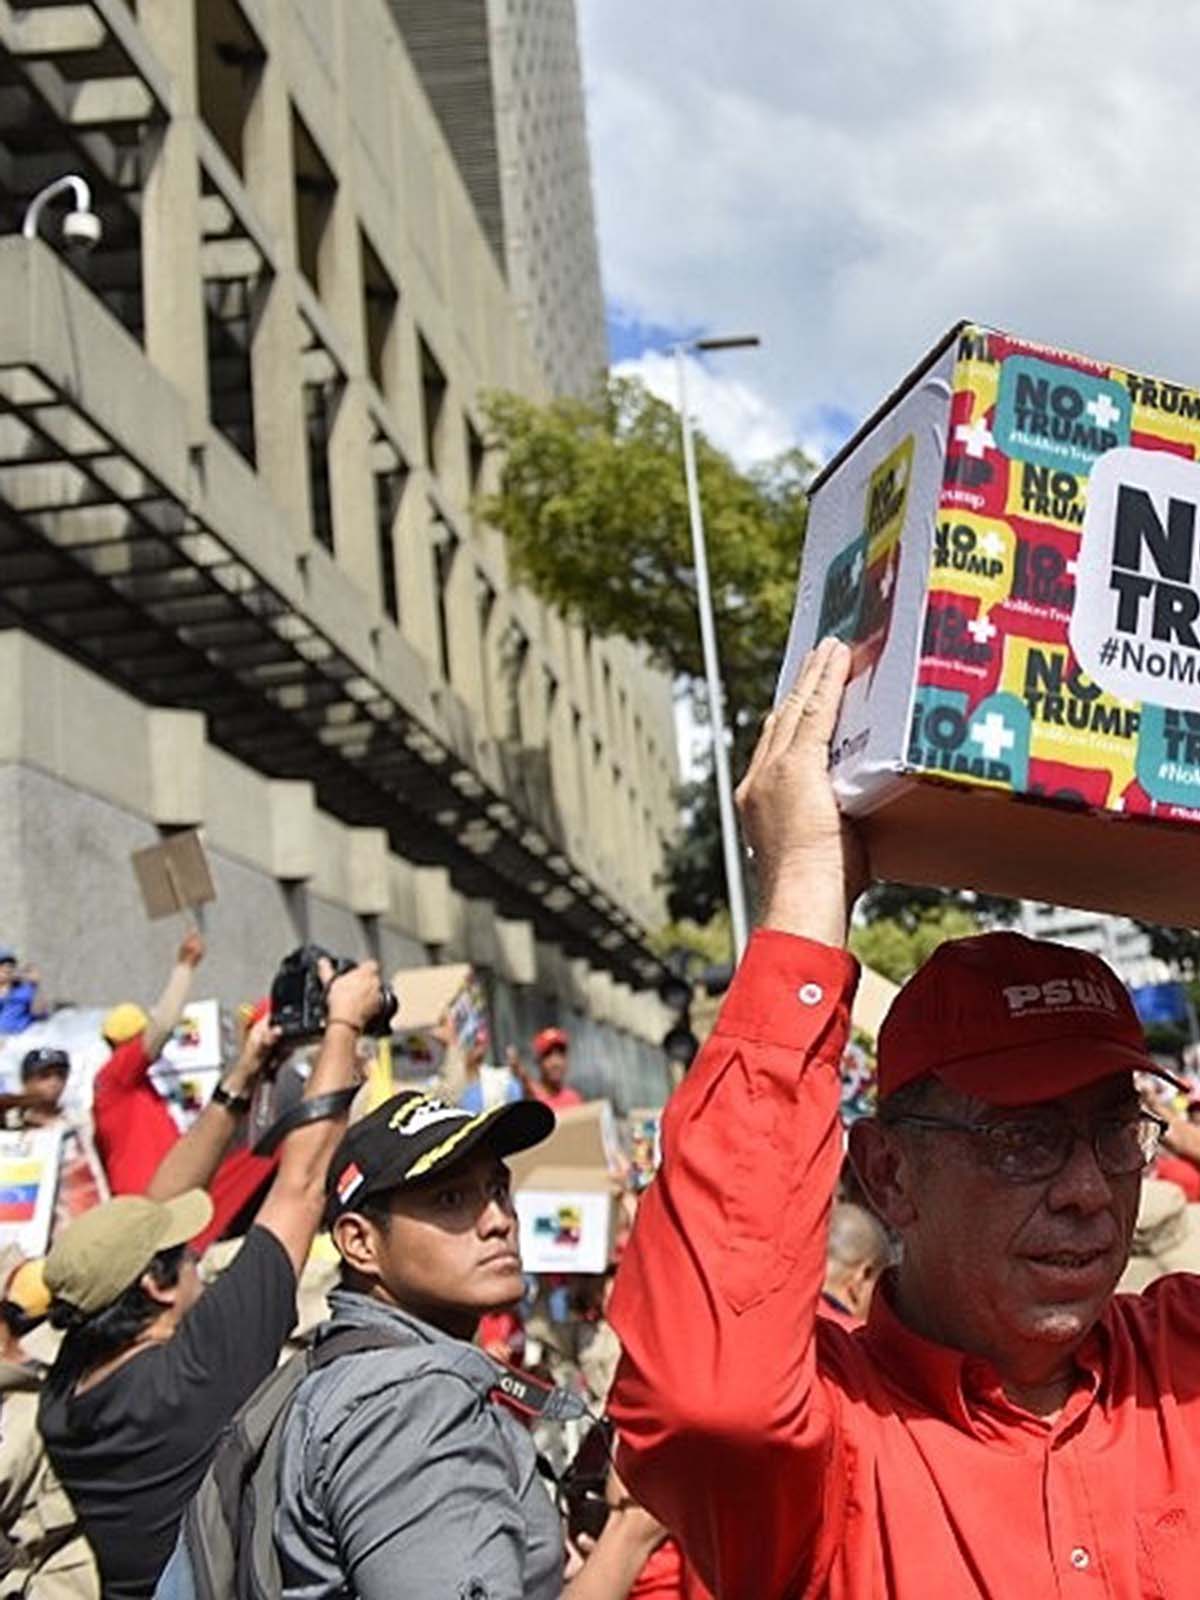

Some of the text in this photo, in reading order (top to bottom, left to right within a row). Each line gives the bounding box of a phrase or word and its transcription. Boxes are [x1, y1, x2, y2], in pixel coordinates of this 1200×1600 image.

[1013, 405, 1119, 452] TRUMP
[1021, 492, 1086, 525] TRUM
[1024, 691, 1142, 740] TRUMP
